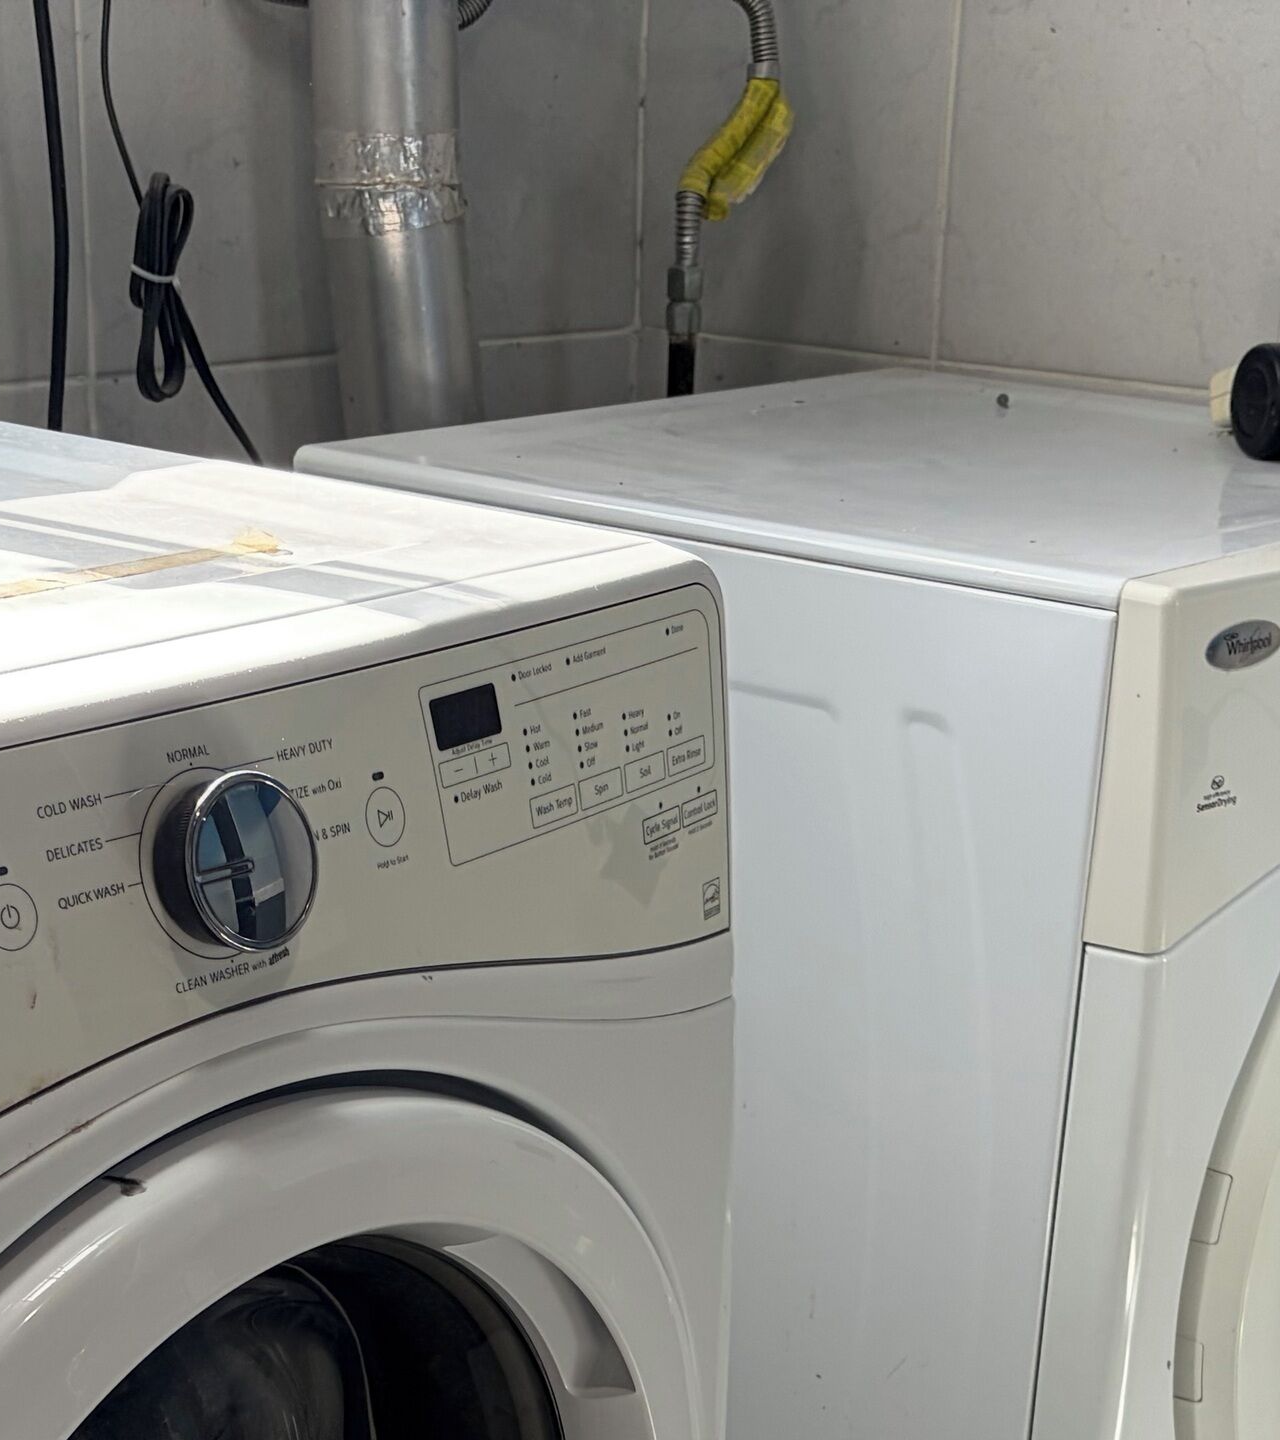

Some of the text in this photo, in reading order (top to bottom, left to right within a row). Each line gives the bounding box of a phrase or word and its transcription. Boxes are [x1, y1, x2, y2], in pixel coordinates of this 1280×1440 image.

[1225, 632, 1273, 656] Whirlpool
[572, 652, 584, 664] Add
[517, 662, 553, 681] Door Locked
[579, 707, 592, 720] Fast
[628, 708, 645, 720] Heavy
[529, 724, 542, 735] Hot
[581, 721, 605, 736] Medium
[630, 721, 649, 736] Normal
[276, 737, 334, 763] HEAVY DUTY
[533, 739, 551, 752] Warm
[583, 740, 599, 753] Slow
[631, 740, 646, 753] Light
[166, 743, 211, 765] NORMAL
[586, 755, 596, 768] Off
[671, 753, 686, 767] Extra
[535, 755, 550, 769] Cool
[537, 772, 552, 785] Cold
[639, 764, 652, 779] Soil
[312, 782, 327, 795] with
[327, 777, 343, 791] Oxi
[460, 780, 503, 804] Delay Wash
[594, 782, 609, 797] Spin
[36, 793, 103, 820] COLD WASH
[535, 796, 573, 817] Wash Temp
[321, 828, 328, 840] &
[329, 821, 351, 838] SPIN
[645, 822, 661, 838] Cycle
[661, 815, 680, 831] Signal
[45, 836, 104, 863] DELICATES
[57, 882, 126, 911] QUICK WASH
[174, 974, 208, 994] CLEAN
[209, 961, 251, 984] WASHER
[251, 960, 267, 972] with
